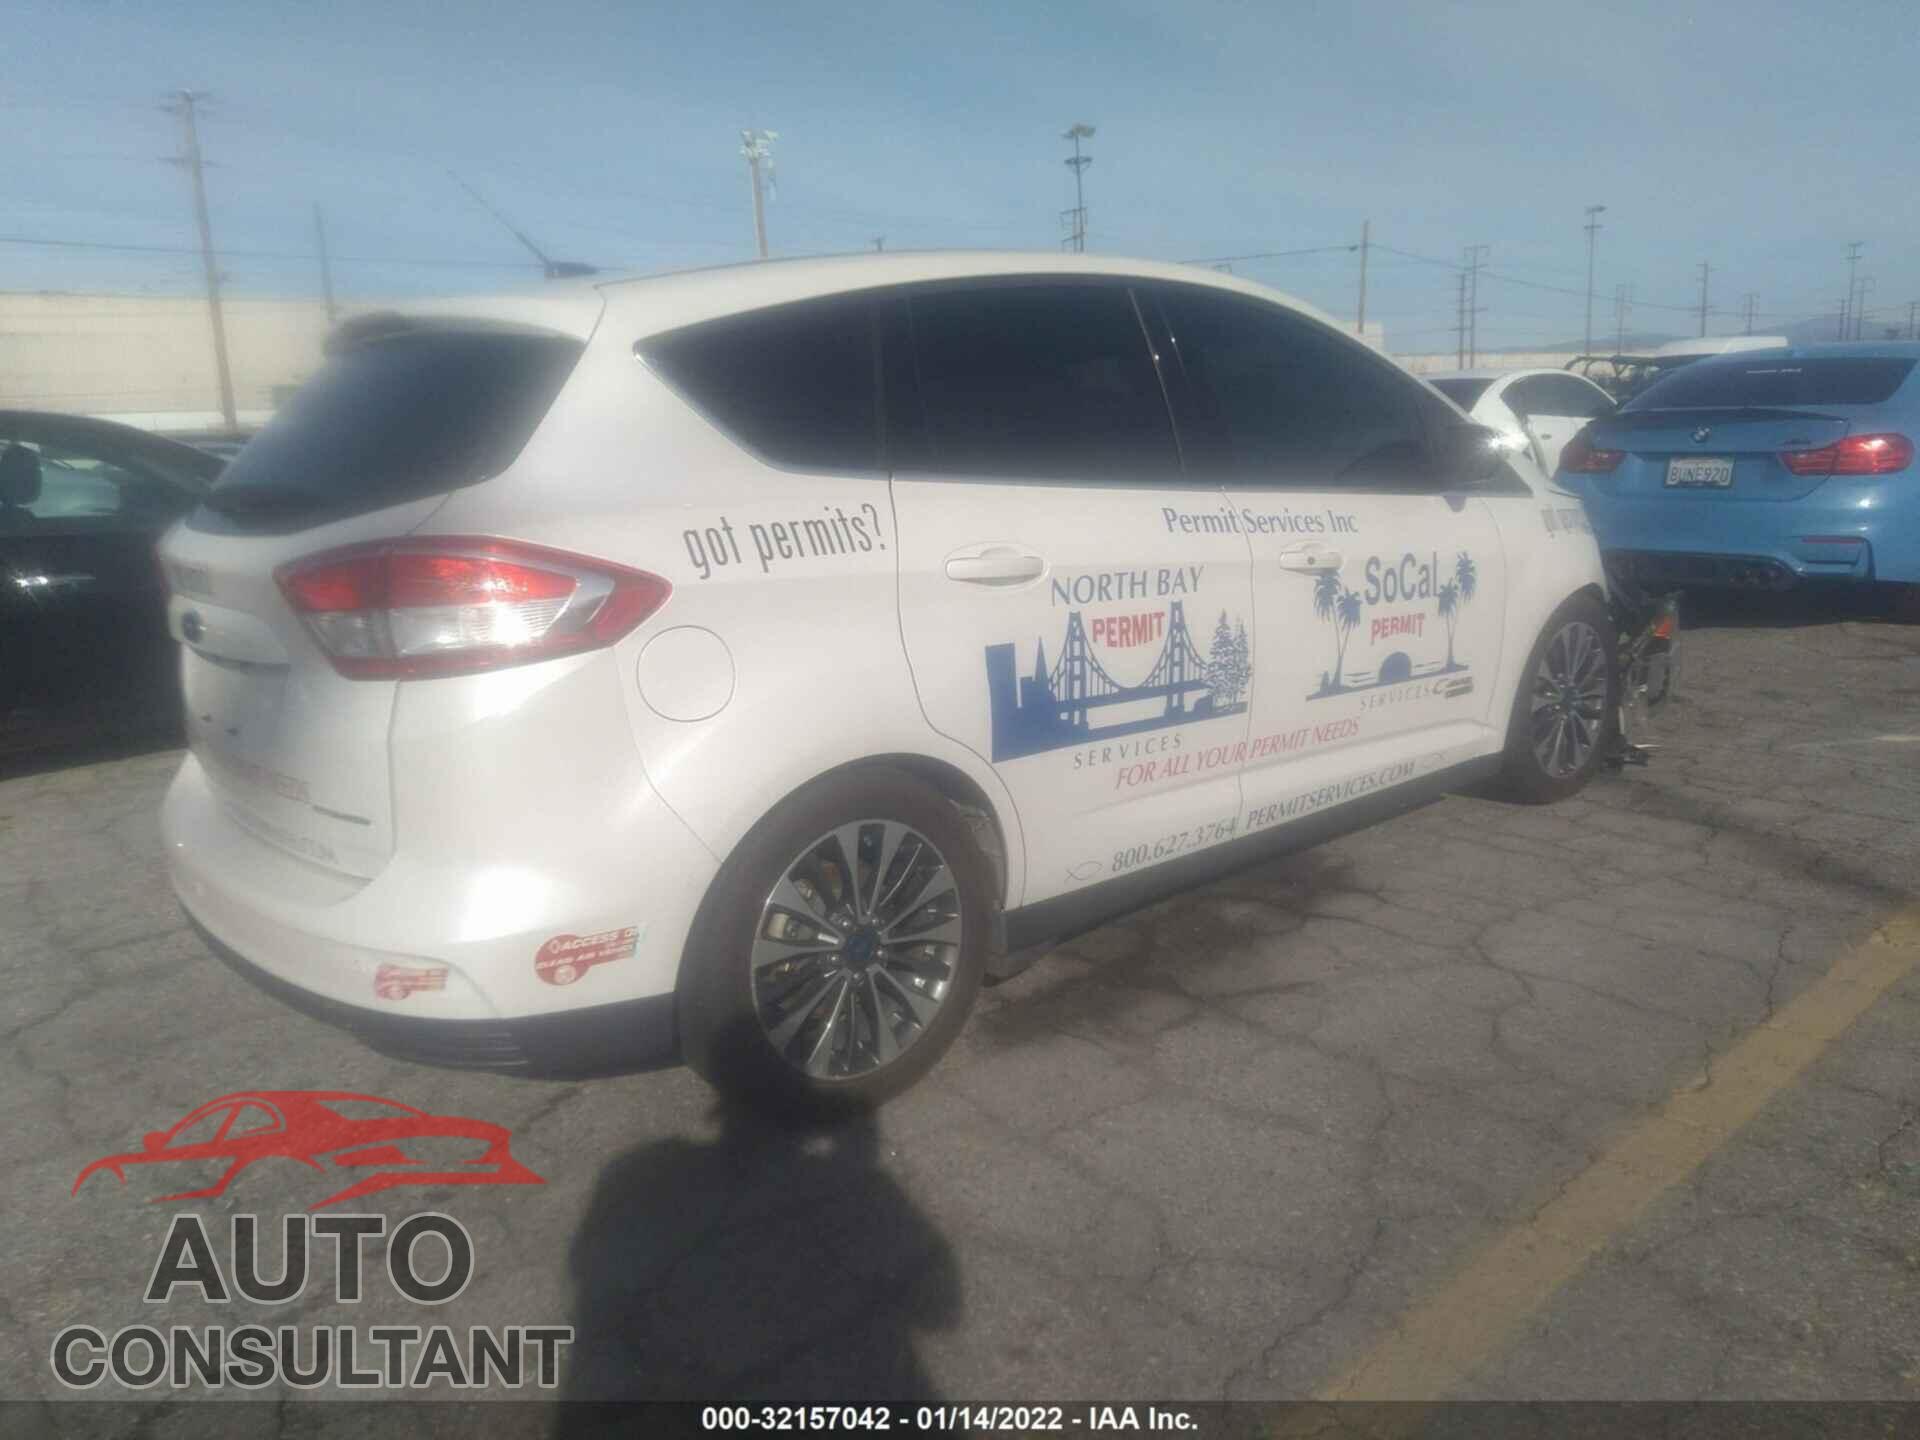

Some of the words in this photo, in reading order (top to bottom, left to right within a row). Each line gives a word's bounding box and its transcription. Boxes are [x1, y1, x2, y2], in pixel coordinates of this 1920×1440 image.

[1161, 506, 1241, 534] Permit
[1242, 508, 1326, 534] Services
[1328, 509, 1360, 533] Inc
[683, 516, 742, 580] got
[749, 503, 886, 573] permits?
[1050, 570, 1148, 607] NORTH
[1157, 565, 1205, 597] BAY
[1365, 551, 1440, 606] SoCal
[1091, 611, 1165, 648] PERMIT
[1370, 612, 1425, 647] PERMIT
[1360, 682, 1430, 712] SERVICES
[1073, 732, 1183, 770] SERVICES
[1114, 761, 1156, 791] FOR
[1160, 753, 1190, 777] ALL
[1196, 741, 1247, 771] YOUR
[1249, 727, 1311, 759] PERMIT
[1311, 715, 1360, 744] NEEDS
[1111, 816, 1237, 872] 800.627.3764
[1246, 760, 1416, 830] PERMITSERVICES.COM
